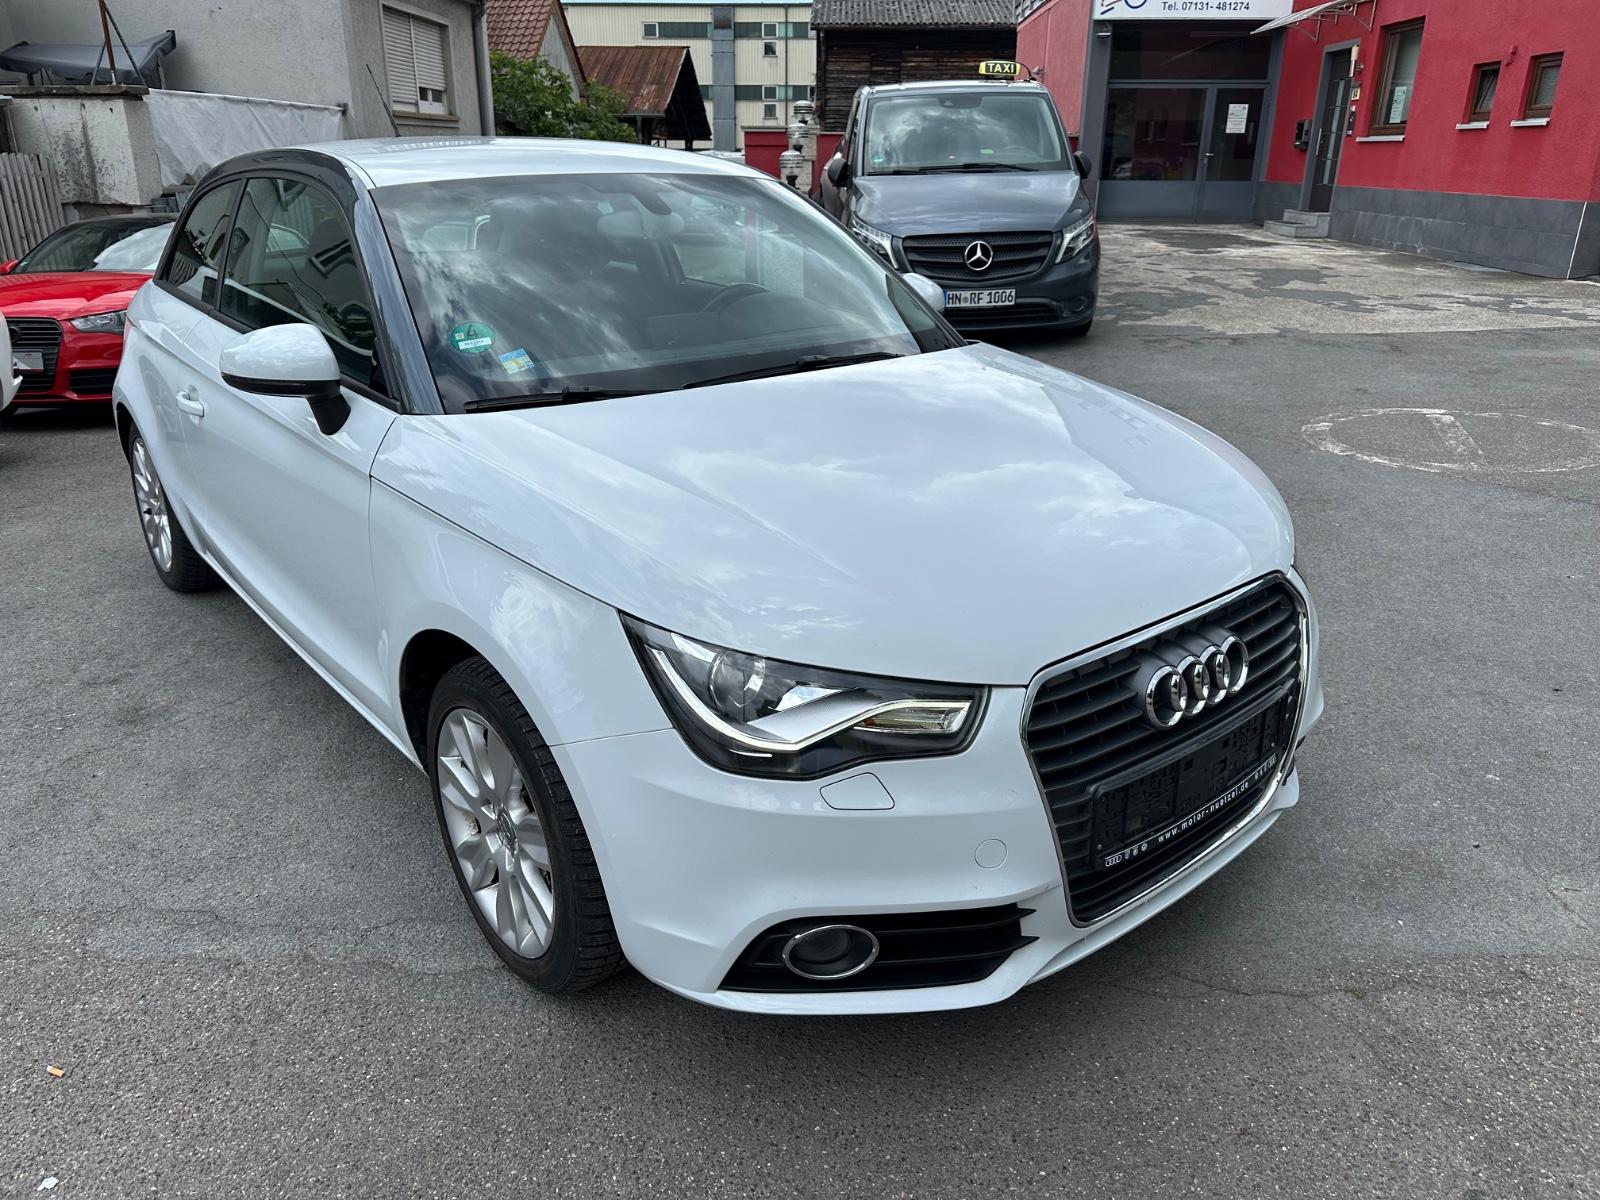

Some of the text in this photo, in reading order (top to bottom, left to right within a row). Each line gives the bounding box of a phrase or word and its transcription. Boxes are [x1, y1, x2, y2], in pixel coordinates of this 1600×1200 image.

[1162, 1, 1179, 11] Tel.
[1215, 1, 1250, 11] 481274
[987, 63, 1014, 73] TAXI
[947, 290, 1014, 305] HN RF 1006
[466, 324, 479, 338] 4
[1158, 781, 1249, 843] www.motor-nuetzel.de
